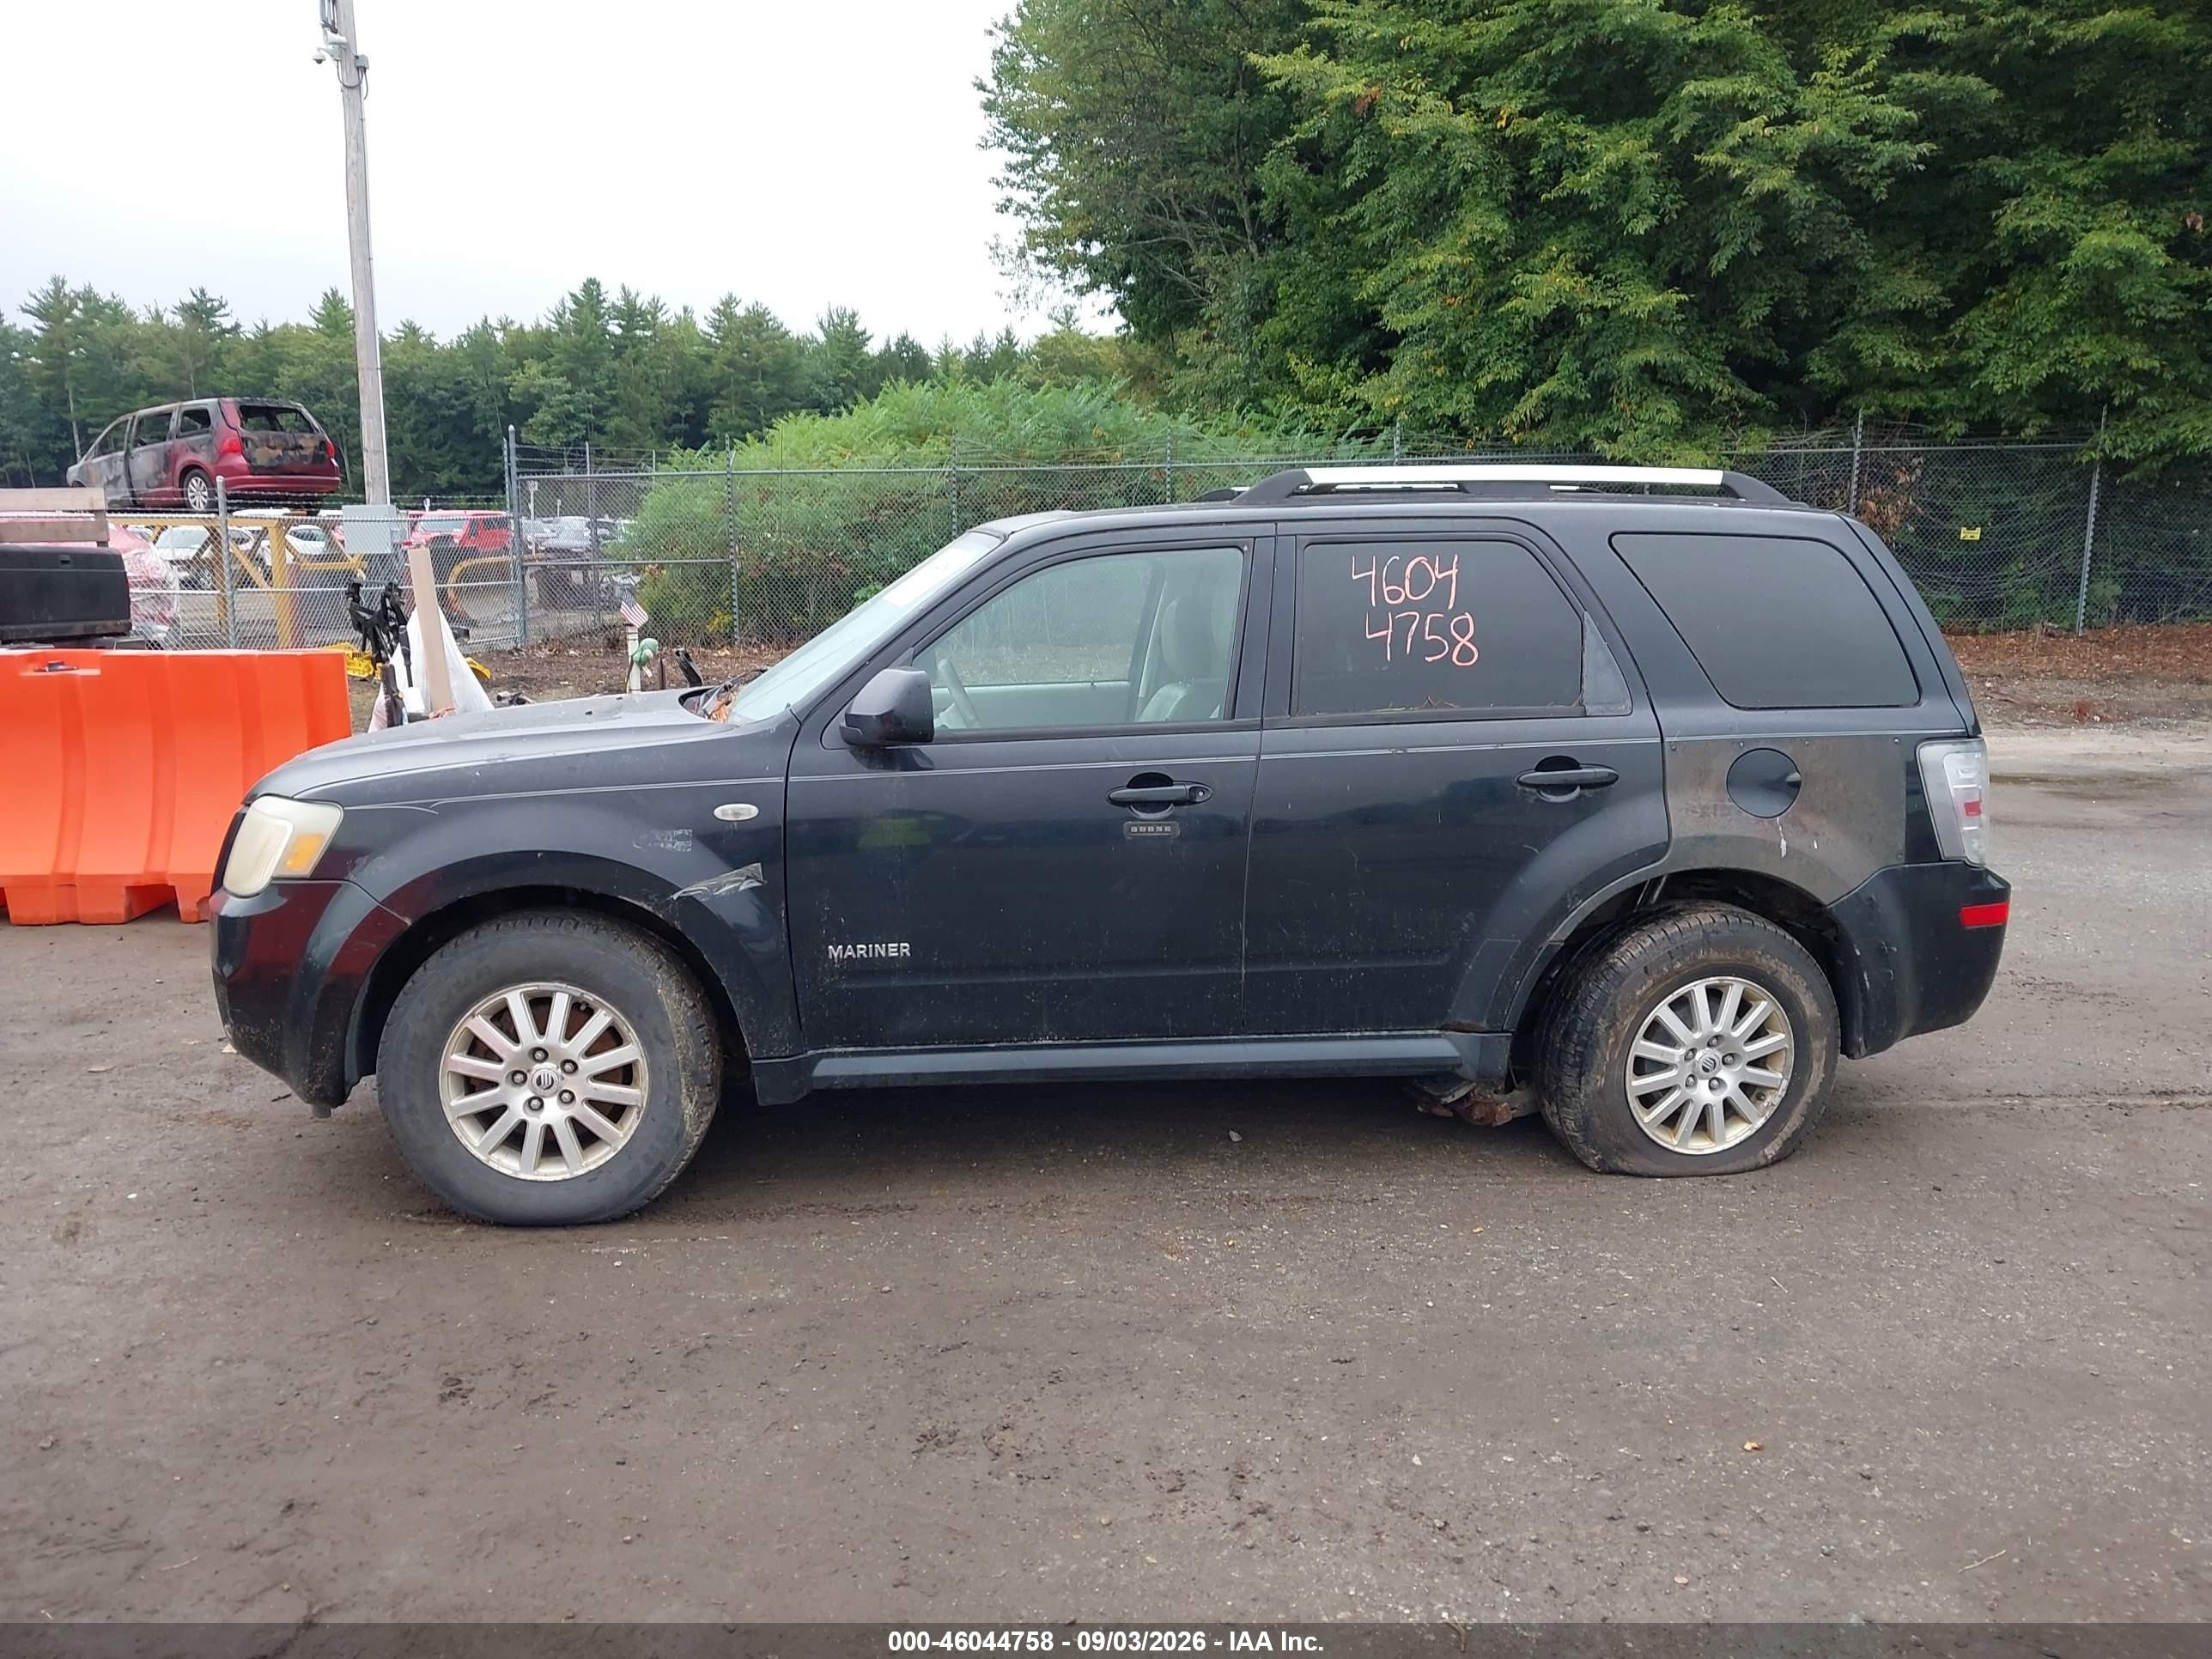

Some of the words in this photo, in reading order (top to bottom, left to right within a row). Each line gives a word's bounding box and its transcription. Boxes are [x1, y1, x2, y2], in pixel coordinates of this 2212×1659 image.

[1352, 554, 1459, 610] 4604
[1365, 611, 1479, 666] 4758
[828, 942, 911, 959] MARINER
